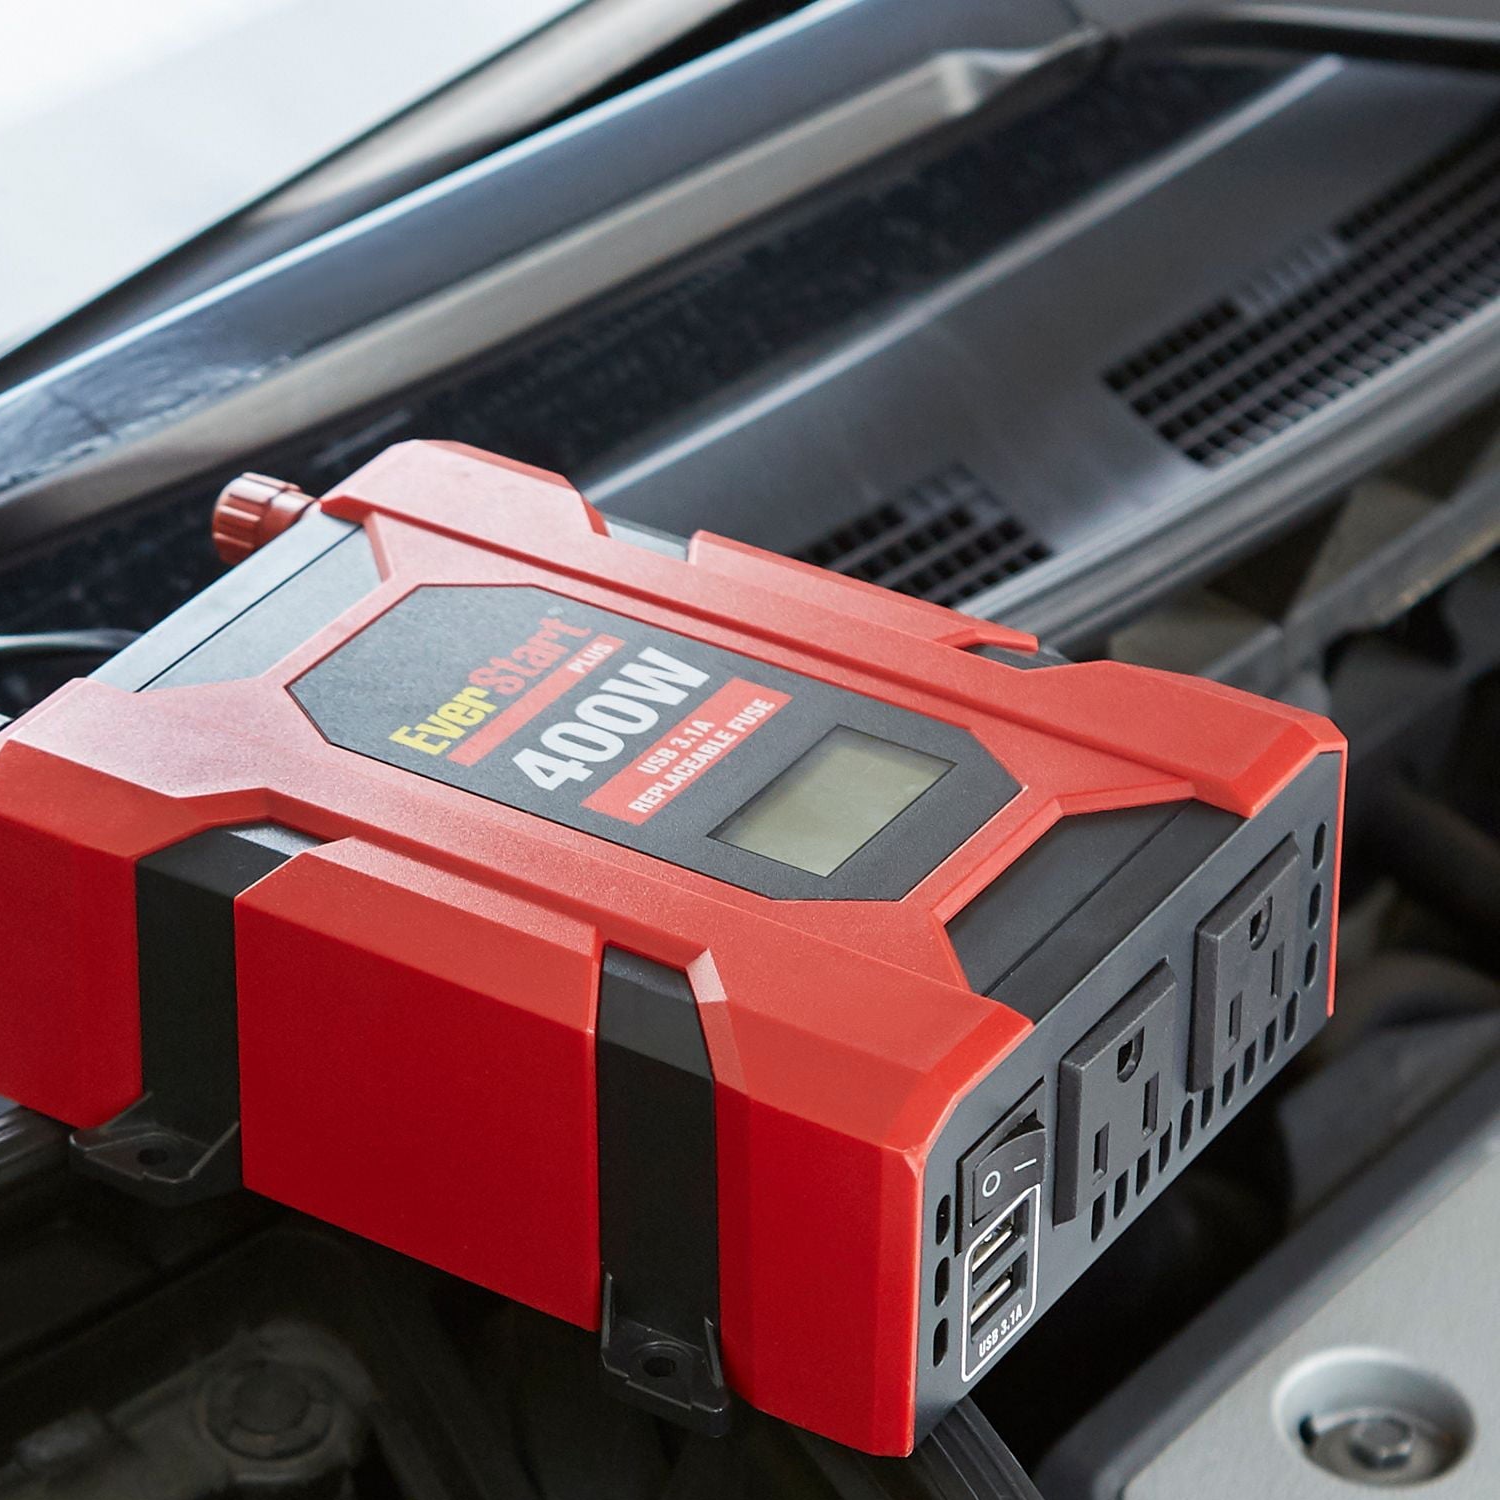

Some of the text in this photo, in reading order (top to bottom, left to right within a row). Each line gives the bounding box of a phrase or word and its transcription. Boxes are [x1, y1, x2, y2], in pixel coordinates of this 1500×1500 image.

[388, 616, 592, 756] EverStart
[566, 642, 615, 675] PLUS
[511, 646, 711, 791] 400W
[627, 697, 776, 814] REPLACEABLE FUSE
[636, 718, 716, 776] USB 3.1A
[978, 1303, 1023, 1358] USB 3.1A
